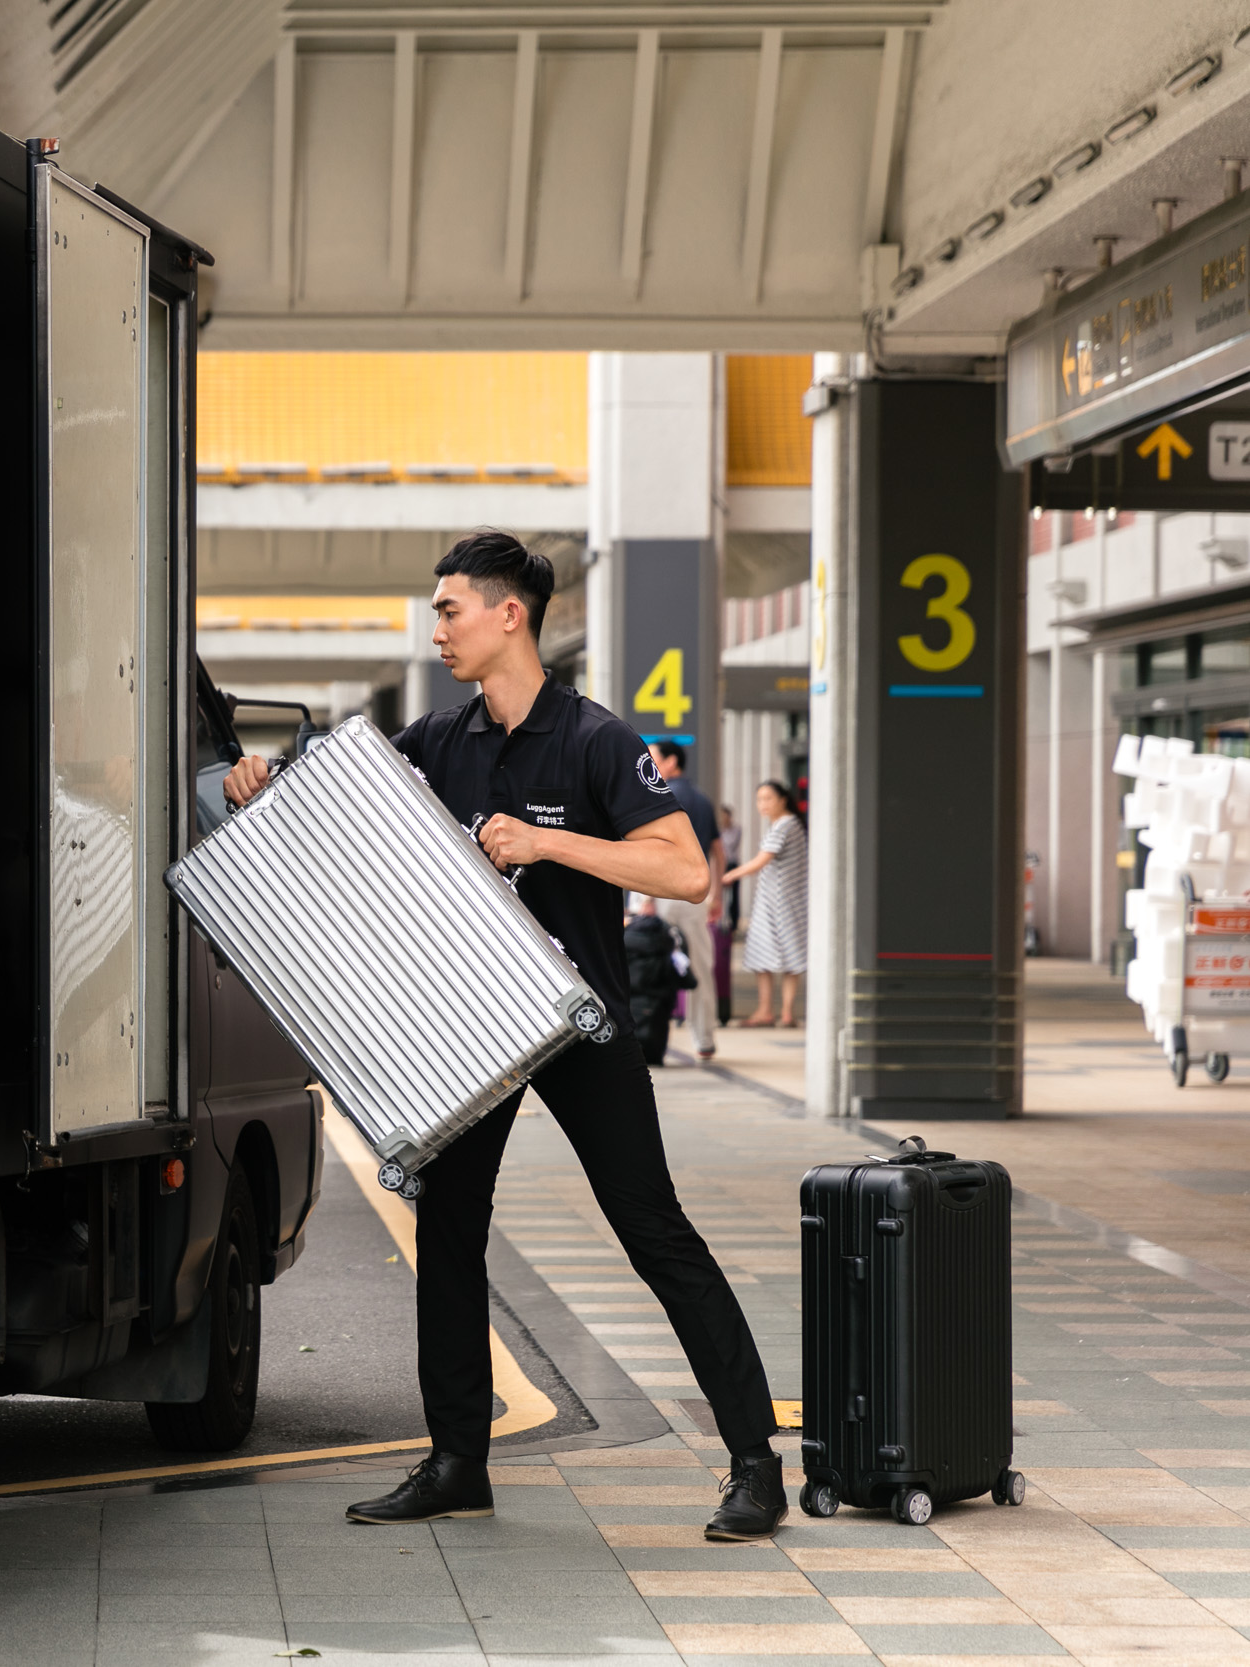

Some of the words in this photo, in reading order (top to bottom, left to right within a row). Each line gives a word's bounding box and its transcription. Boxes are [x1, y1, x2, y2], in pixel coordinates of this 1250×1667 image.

[897, 552, 977, 673] 3
[633, 648, 693, 728] 4
[526, 803, 565, 814] LuggAgent
